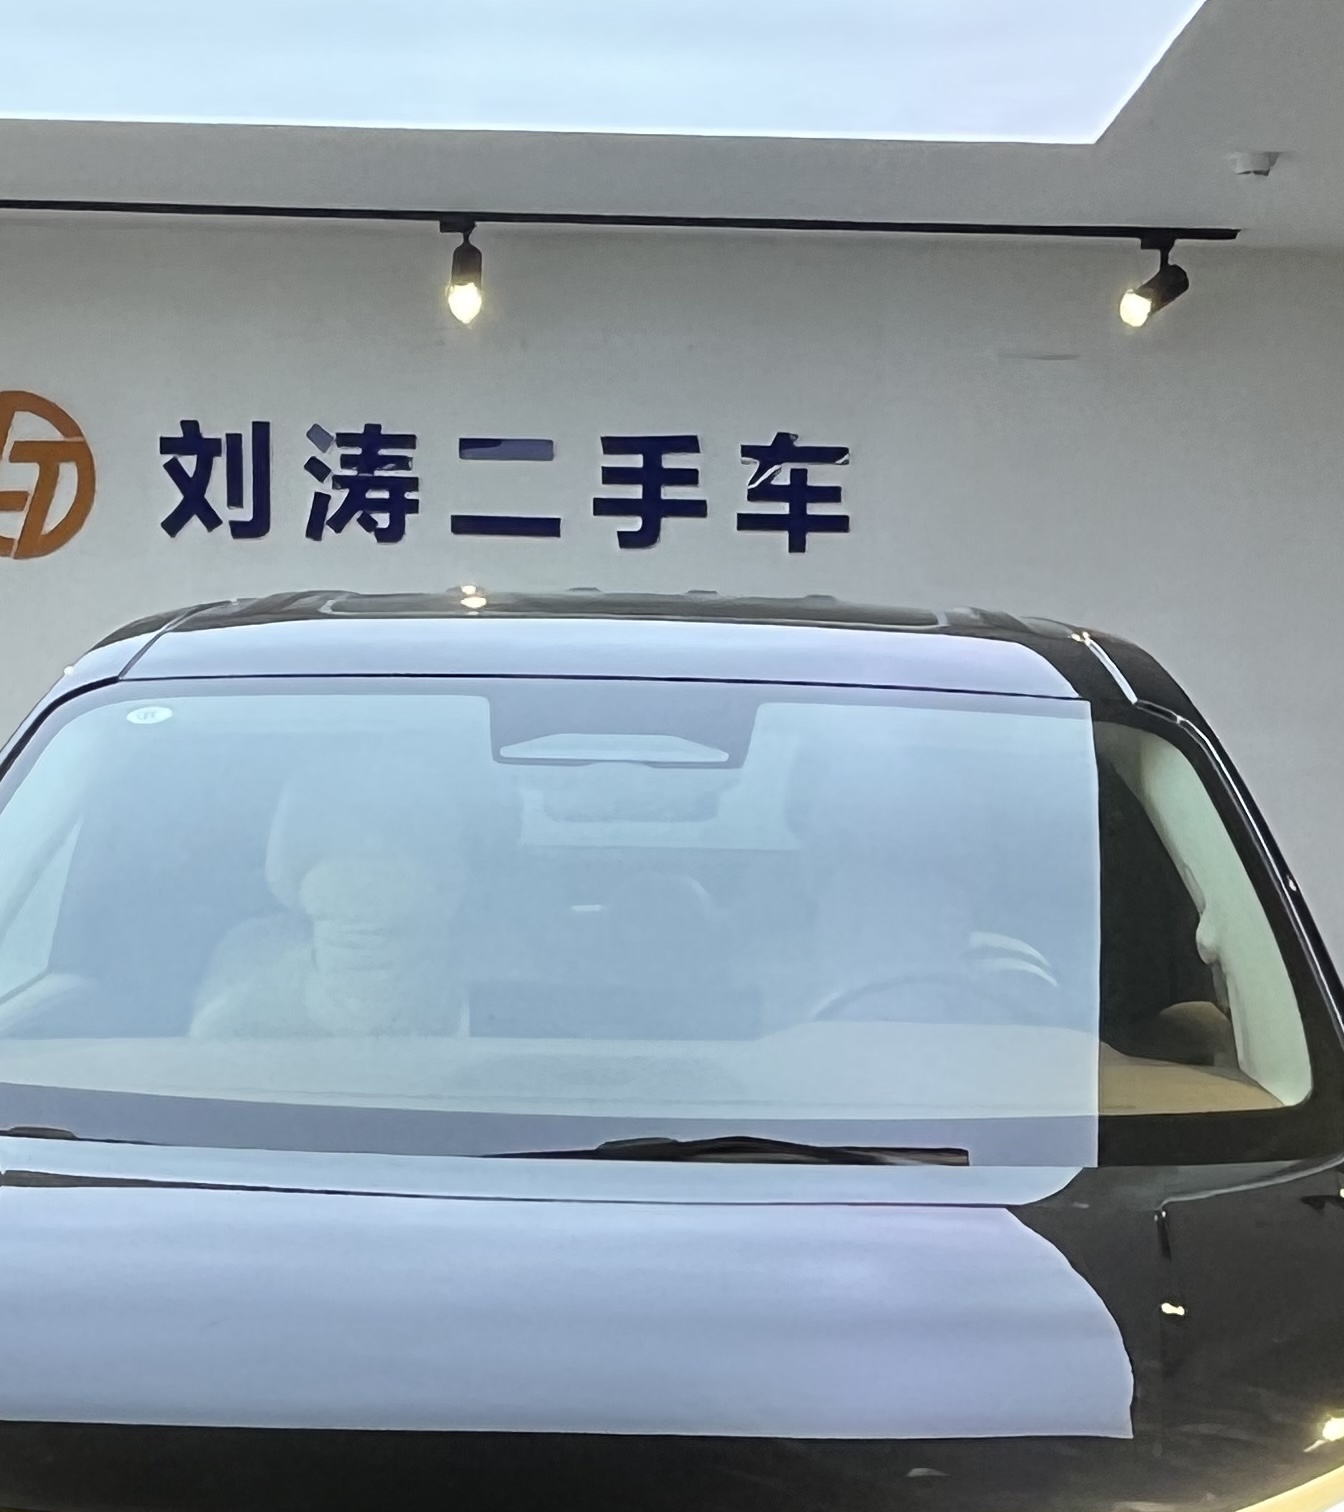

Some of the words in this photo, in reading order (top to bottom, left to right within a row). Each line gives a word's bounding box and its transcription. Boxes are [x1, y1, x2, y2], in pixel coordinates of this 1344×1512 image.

[159, 420, 851, 553] 刘涛二手车
